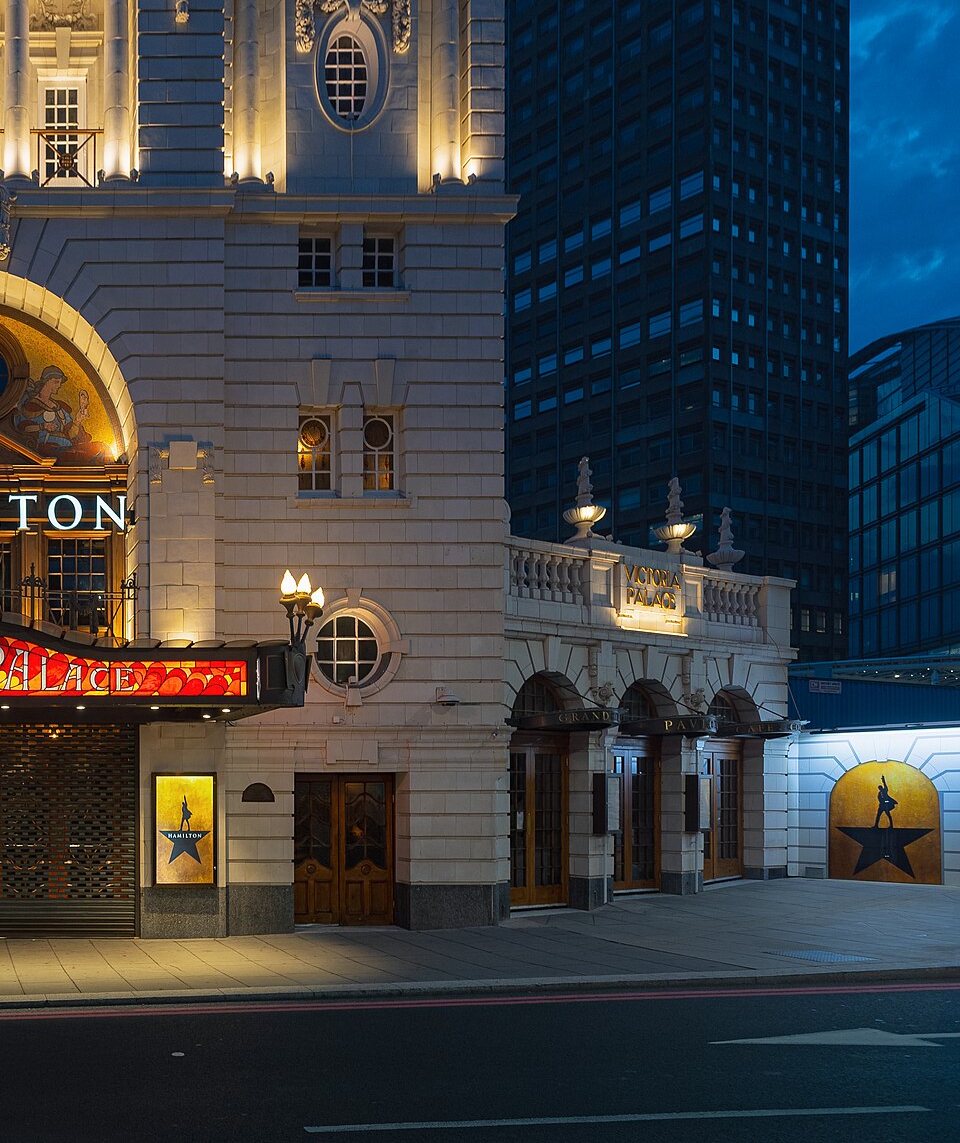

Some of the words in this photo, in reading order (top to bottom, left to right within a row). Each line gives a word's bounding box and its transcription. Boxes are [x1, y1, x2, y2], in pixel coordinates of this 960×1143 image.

[624, 565, 681, 590] VICTORIA
[626, 586, 677, 610] PALACE
[558, 711, 610, 723] GRAND
